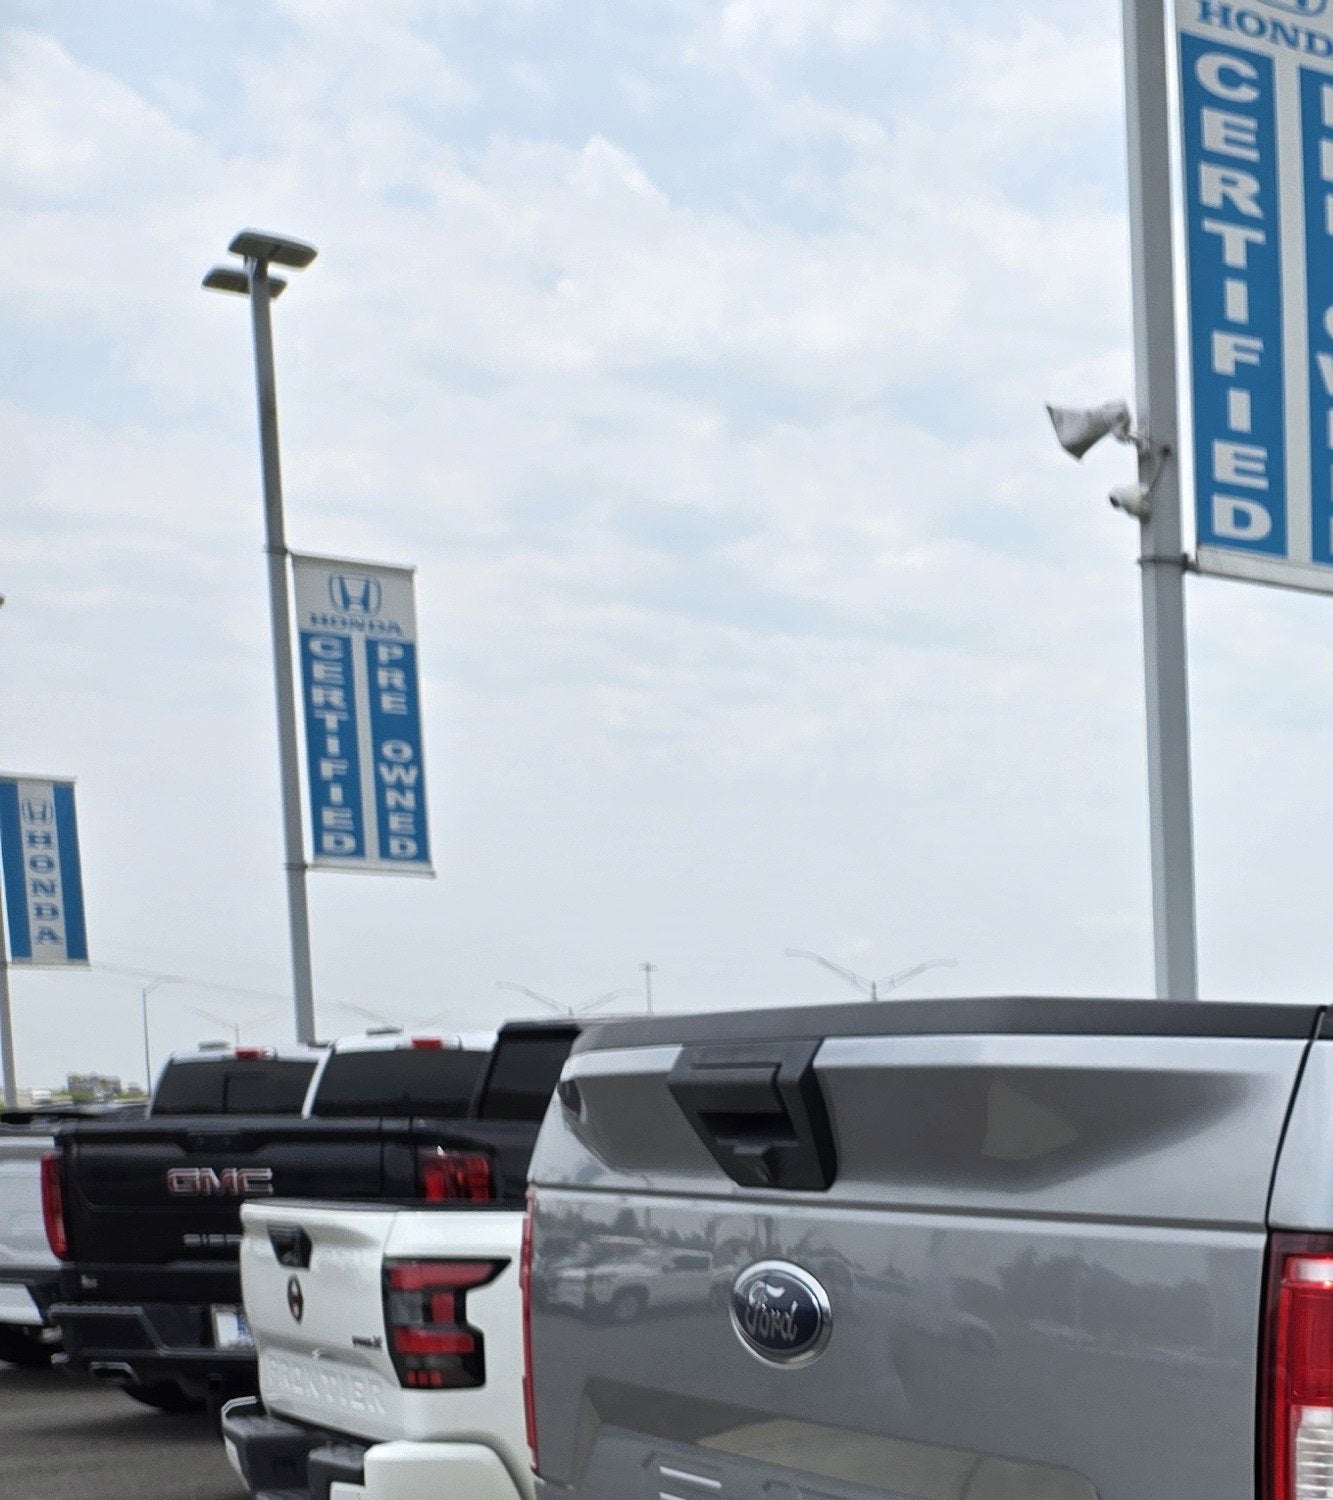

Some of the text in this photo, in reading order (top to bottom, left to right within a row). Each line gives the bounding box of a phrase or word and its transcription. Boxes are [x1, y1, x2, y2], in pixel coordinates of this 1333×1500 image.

[1195, 53, 1272, 542] CERTIFIED
[309, 612, 405, 636] HONDA
[308, 636, 357, 855] CERTIFIED
[376, 641, 419, 859] PRE OWNED
[26, 831, 62, 945] HONDA
[167, 1167, 274, 1196] GMC
